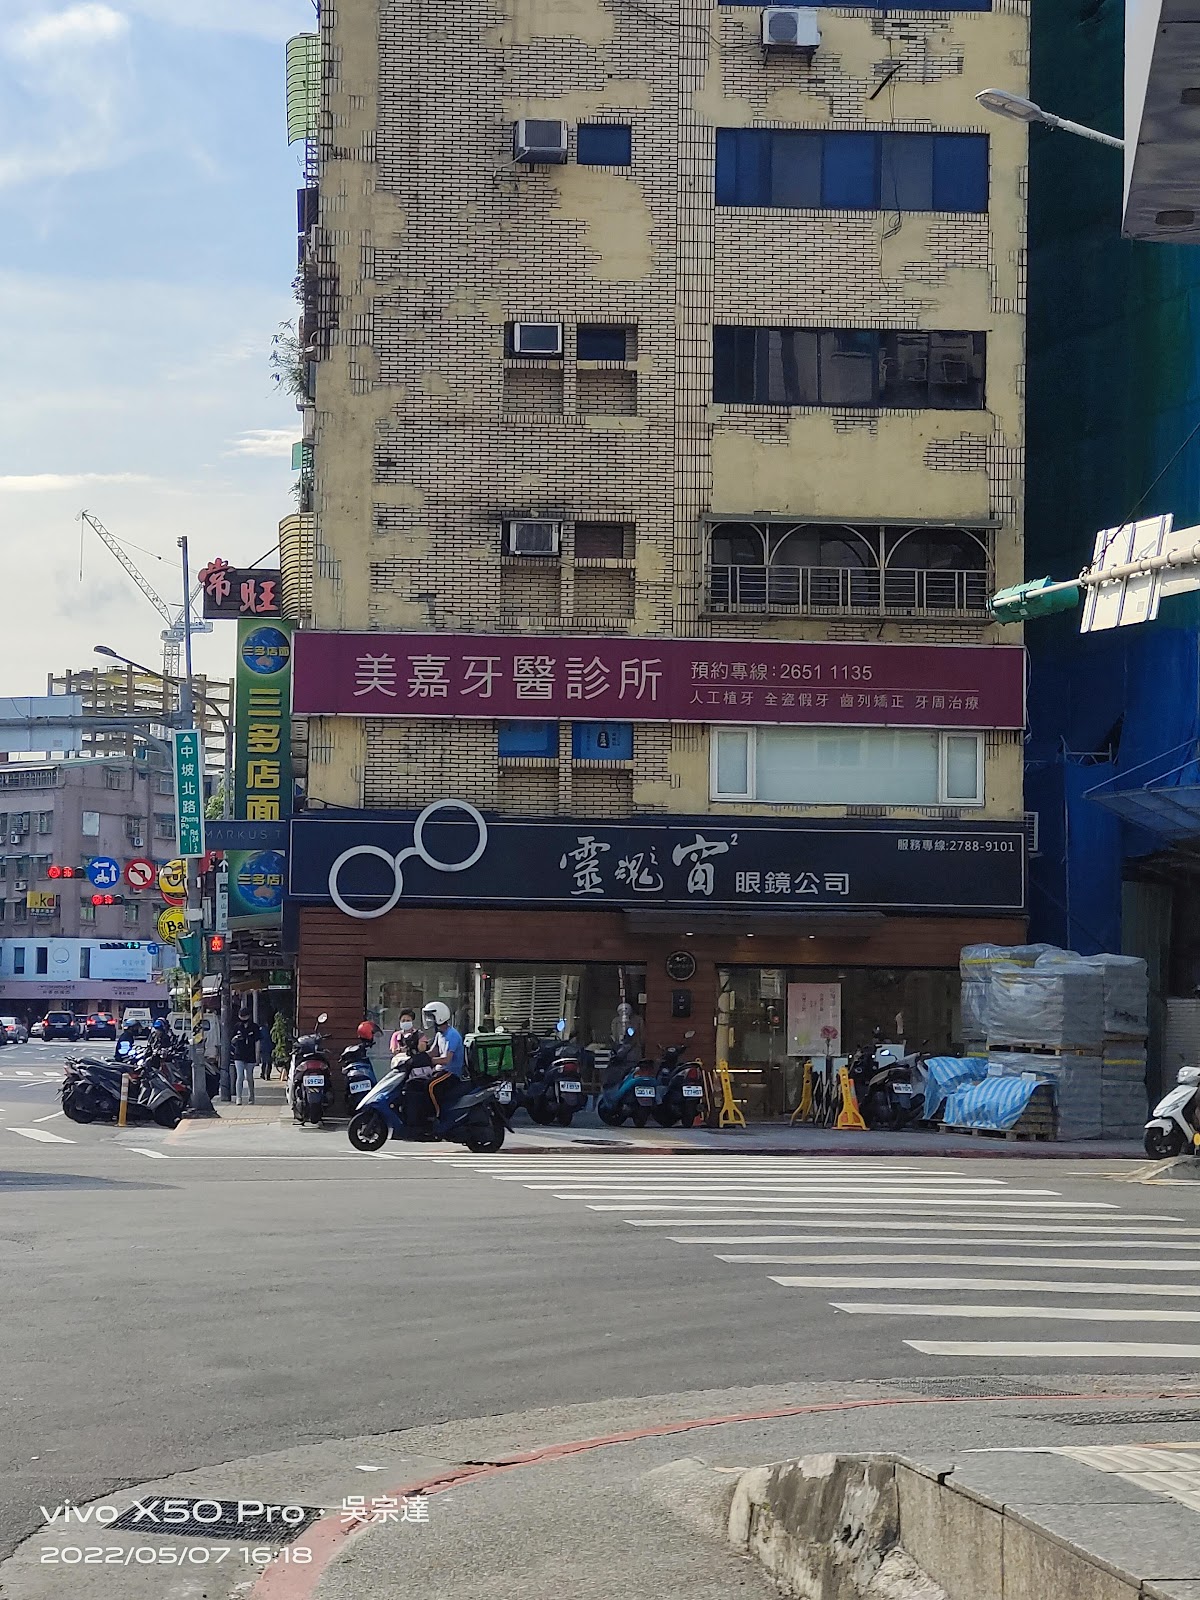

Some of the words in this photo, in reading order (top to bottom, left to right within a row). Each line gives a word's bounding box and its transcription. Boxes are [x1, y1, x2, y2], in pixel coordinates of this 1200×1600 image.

[198, 558, 278, 613] 常旺
[243, 646, 290, 656] 三多店面
[353, 653, 663, 701] 美嘉牙醫診所
[689, 690, 754, 706] 人工植牙
[765, 692, 830, 708] 全瓷假牙
[839, 693, 904, 709] 齒列矯正
[915, 695, 980, 710] 牙周治療
[246, 688, 281, 820] 三多店面
[180, 745, 196, 814] 中坡北路
[180, 816, 199, 824] Zhong
[205, 829, 268, 840] MARKUS
[897, 839, 1015, 852] 服務專線:2788-9101
[238, 873, 284, 885] 三多店
[735, 871, 850, 895] 眼鏡公司
